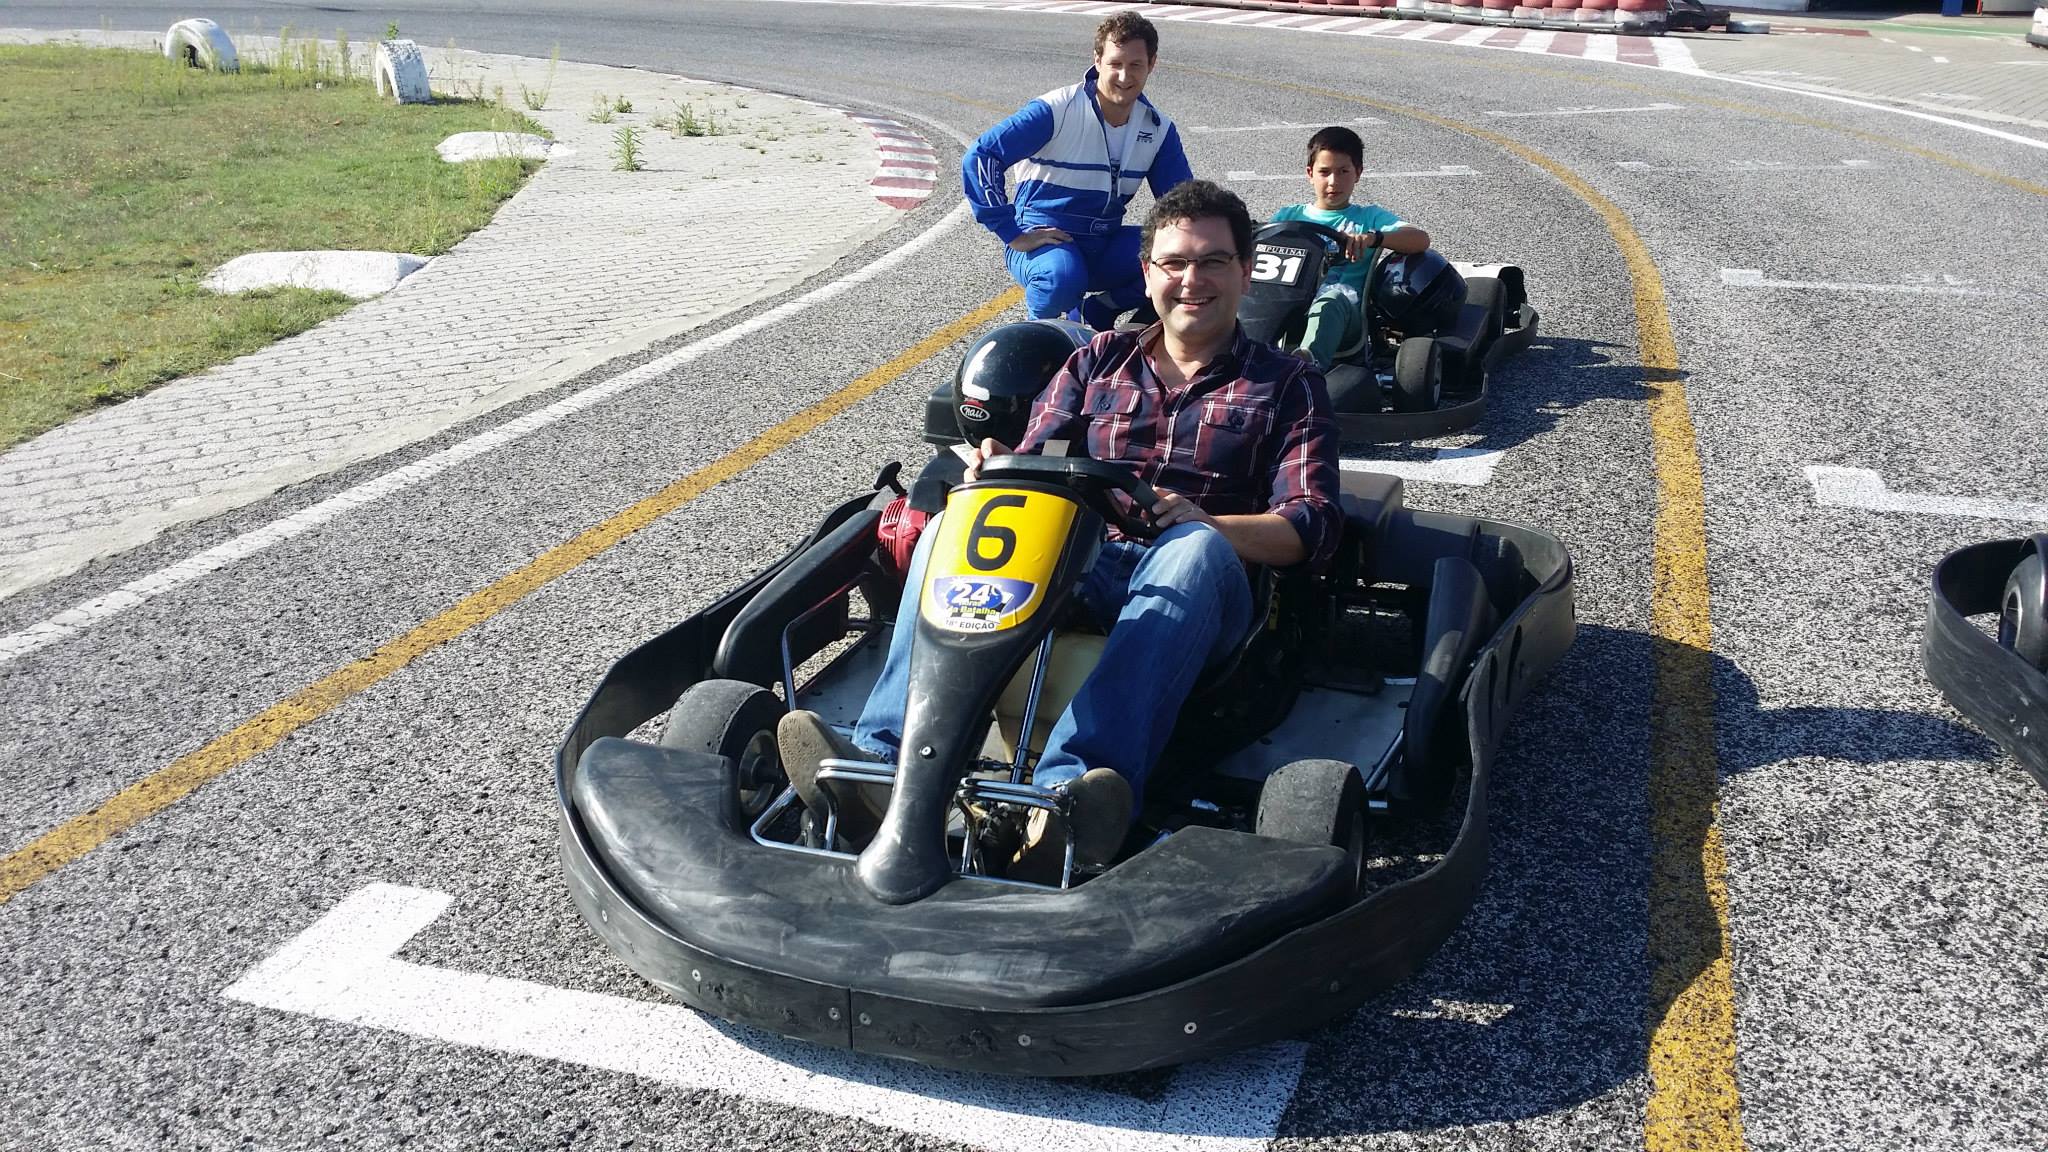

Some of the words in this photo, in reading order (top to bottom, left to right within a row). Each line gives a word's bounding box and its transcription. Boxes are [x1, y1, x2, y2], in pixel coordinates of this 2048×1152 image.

[1265, 245, 1304, 256] PURINA
[1251, 254, 1302, 283] 31
[966, 494, 1028, 571] 6
[951, 583, 990, 604] 24
